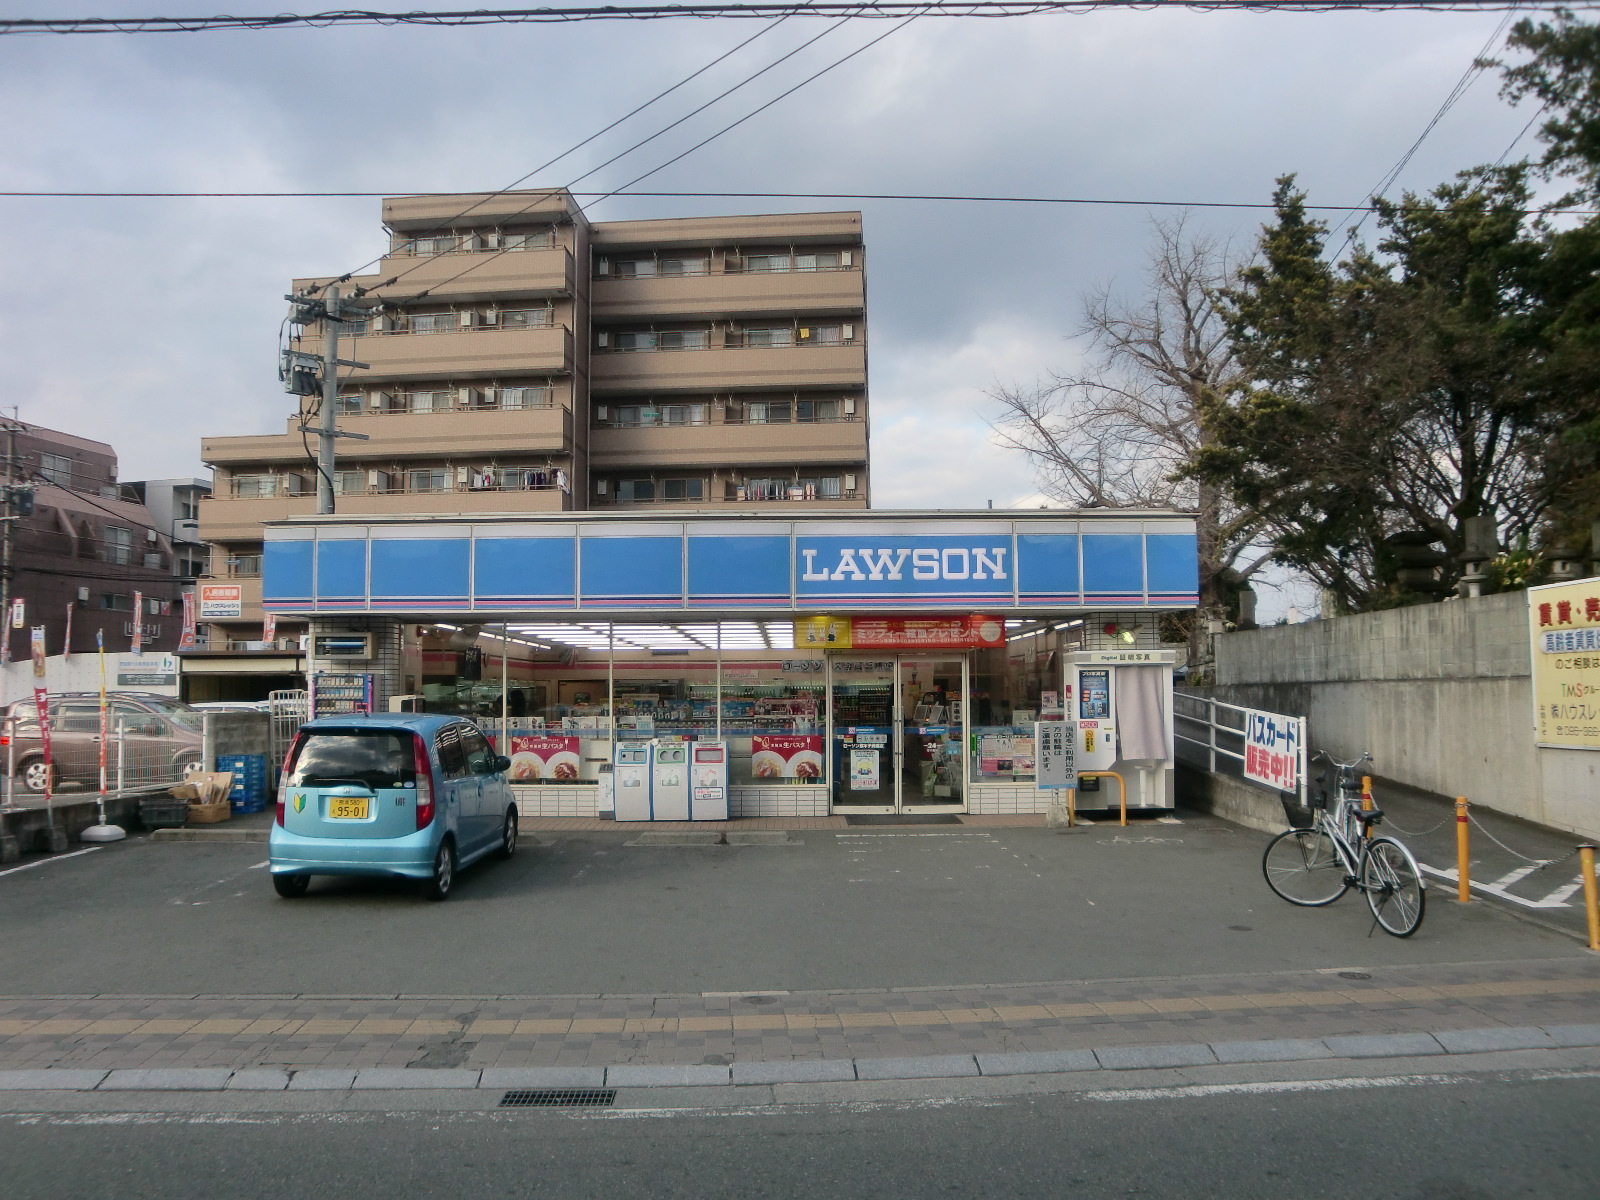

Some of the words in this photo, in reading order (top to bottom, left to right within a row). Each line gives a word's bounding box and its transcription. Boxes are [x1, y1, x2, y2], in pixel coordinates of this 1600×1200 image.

[802, 548, 1007, 581] LAWSON
[1551, 703, 1600, 720] ㈱ハウスレ
[1042, 726, 1051, 772] ご遠慮願います。
[1053, 726, 1062, 756] 方の駐輪は
[1065, 726, 1074, 780] 当店をご利用以外の
[337, 806, 365, 817] 95-01
